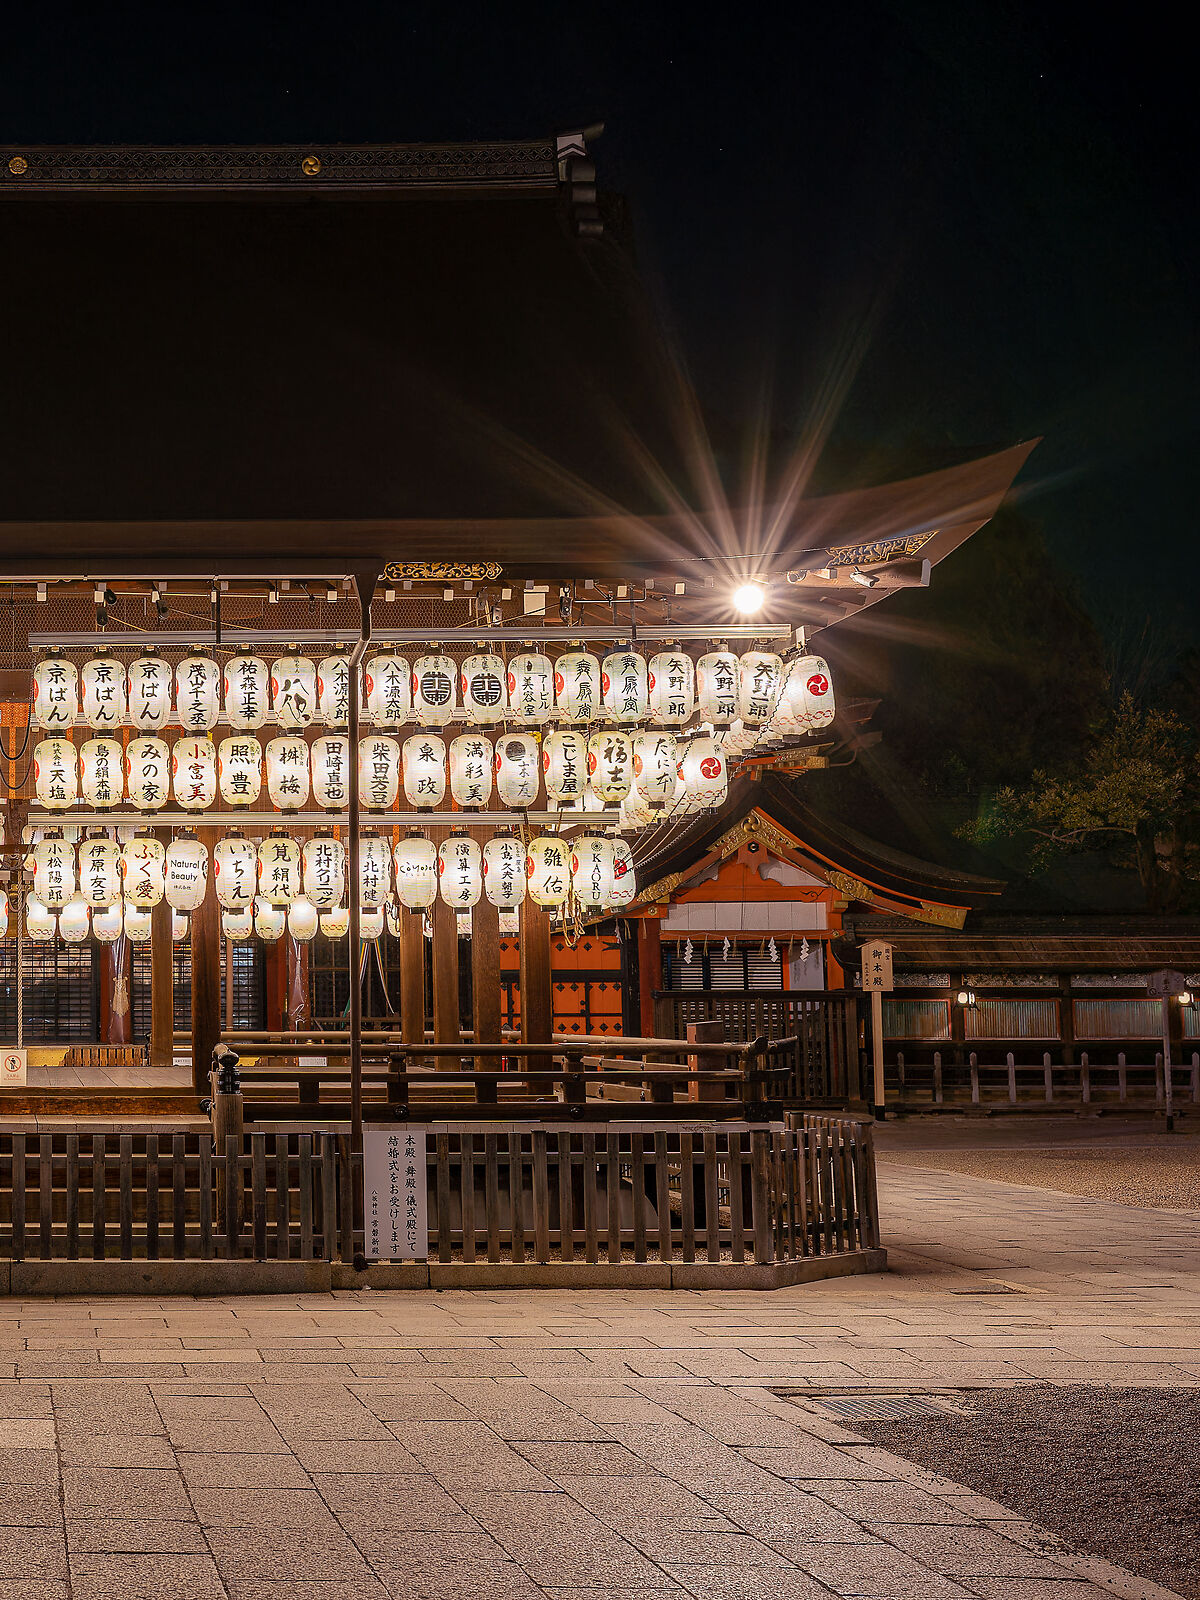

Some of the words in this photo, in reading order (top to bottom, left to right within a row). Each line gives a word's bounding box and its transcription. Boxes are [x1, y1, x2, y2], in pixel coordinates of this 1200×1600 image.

[47, 664, 69, 721] 京ばん
[93, 663, 115, 721] 京ばん
[139, 662, 160, 720] 京ばん
[187, 663, 207, 725] 茂山千之丞
[236, 660, 259, 721] 祐森正幸
[383, 661, 402, 721] 八木源太郎
[522, 676, 536, 716] 美容室
[538, 674, 549, 710] アービル
[667, 658, 686, 717] 矢野一郎
[713, 660, 735, 718] 矢野一郎
[747, 661, 774, 719] 矢野一郎
[141, 744, 161, 801] みの家
[229, 745, 251, 795] 照豊
[325, 742, 345, 800] 田崎真也
[417, 743, 439, 795] 泉政
[559, 735, 578, 794] こじま屋
[47, 844, 62, 902] 小松陽一郎
[134, 843, 154, 900] ふく愛
[171, 860, 200, 870] Natural
[171, 872, 198, 882] Beauty
[230, 844, 249, 900] いちえ
[363, 860, 379, 902] 北村健
[591, 853, 601, 900] KAORU
[872, 949, 883, 986] 御本殿
